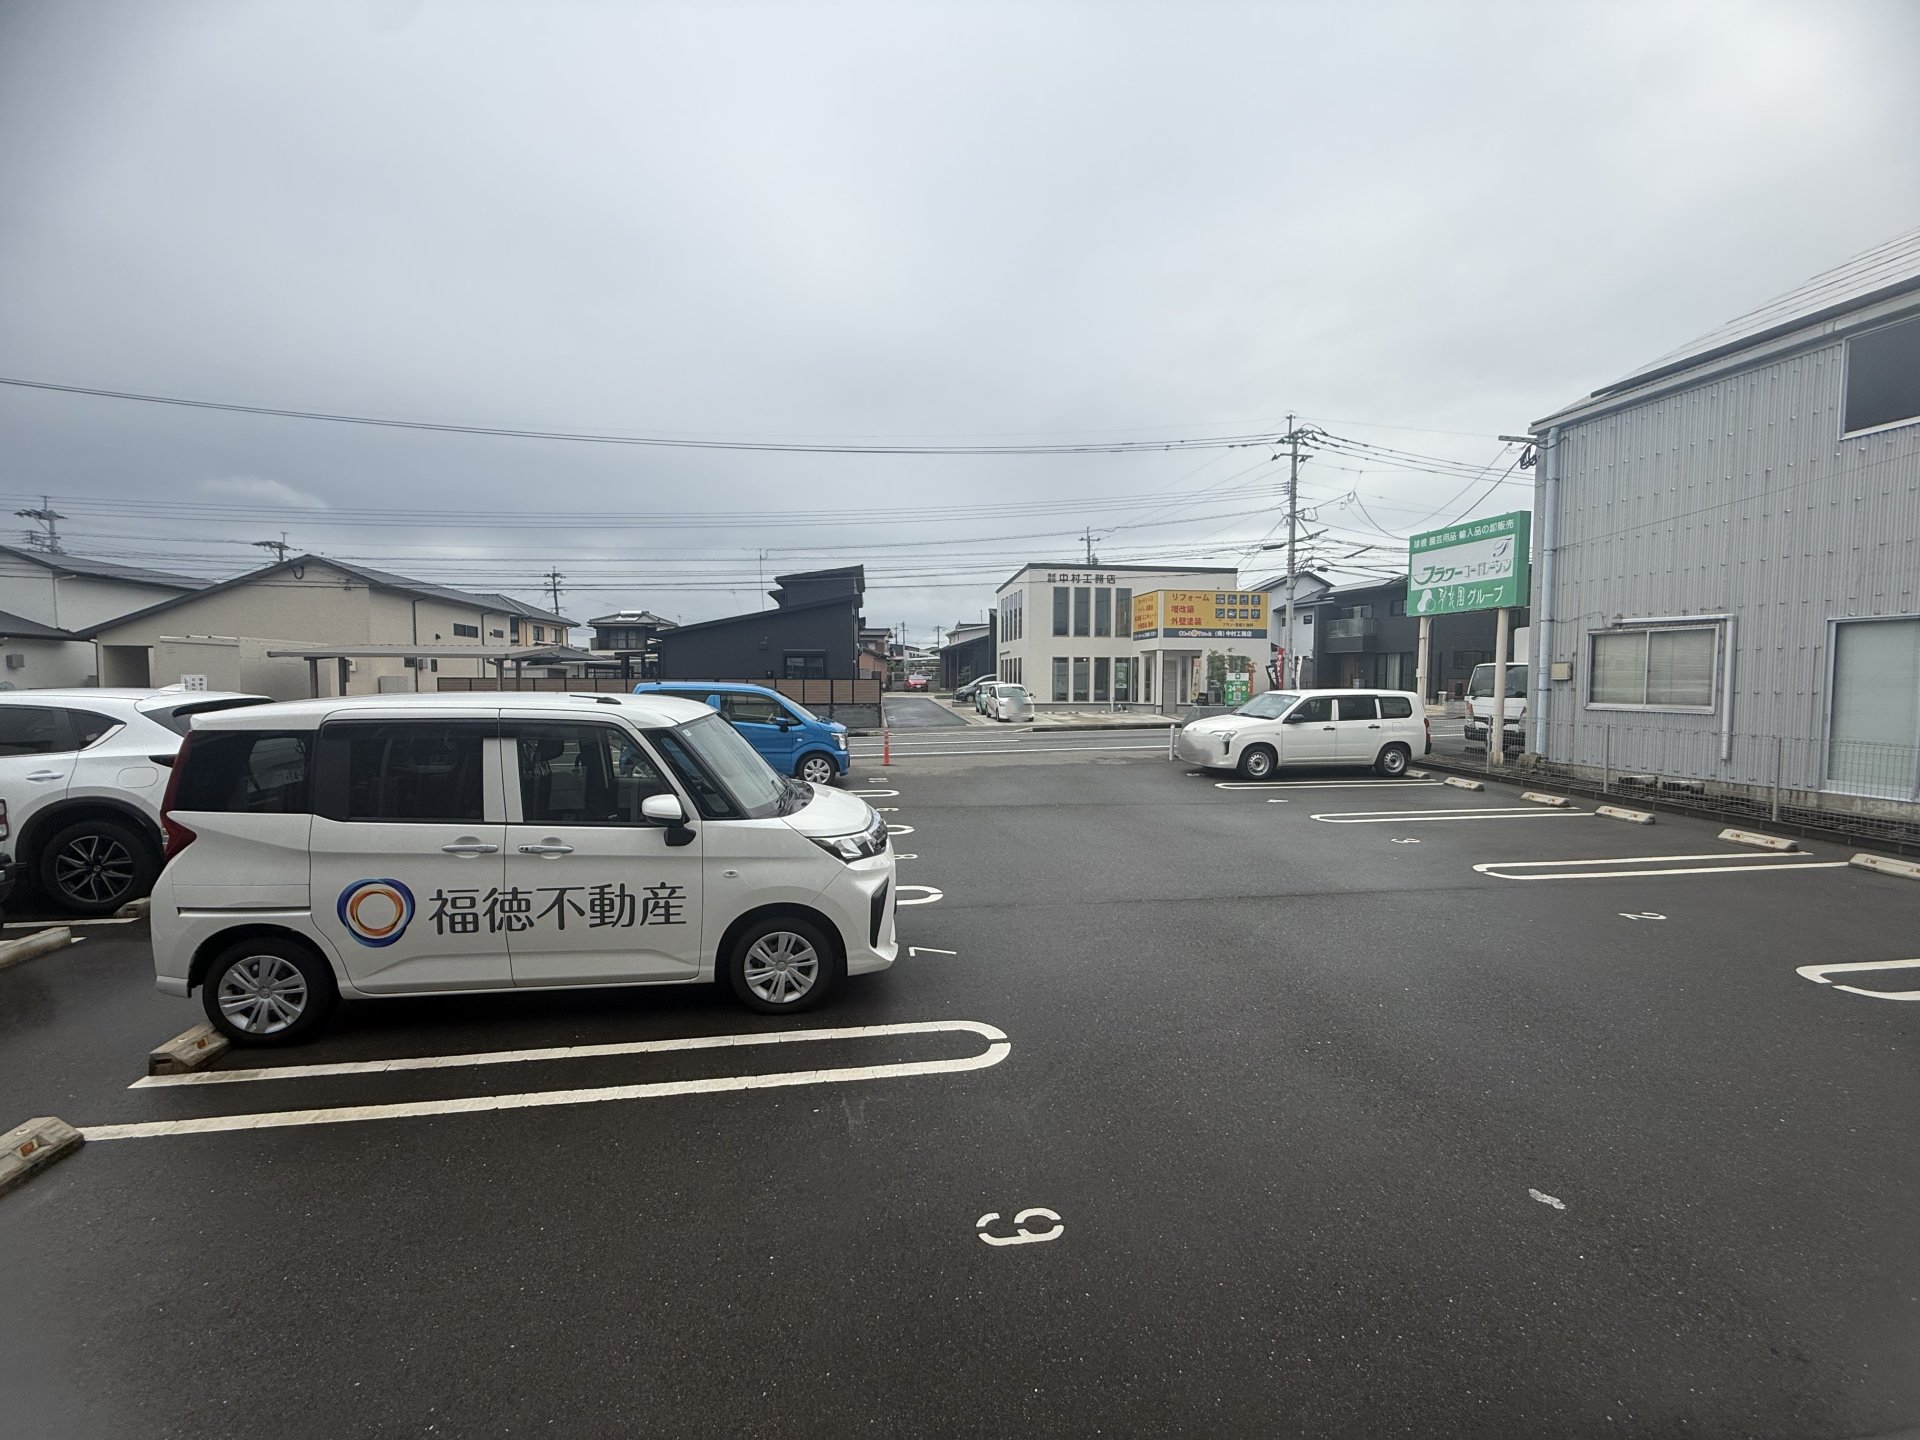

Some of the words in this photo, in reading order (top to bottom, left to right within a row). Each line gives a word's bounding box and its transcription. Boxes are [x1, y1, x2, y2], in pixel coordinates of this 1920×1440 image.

[1172, 593, 1210, 602] リフォーム
[1171, 605, 1195, 614] 増改築
[1171, 617, 1202, 626] 外壁塗装
[428, 881, 687, 936] 福徳不動産
[908, 946, 957, 957] 7
[975, 1207, 1065, 1247] 6
